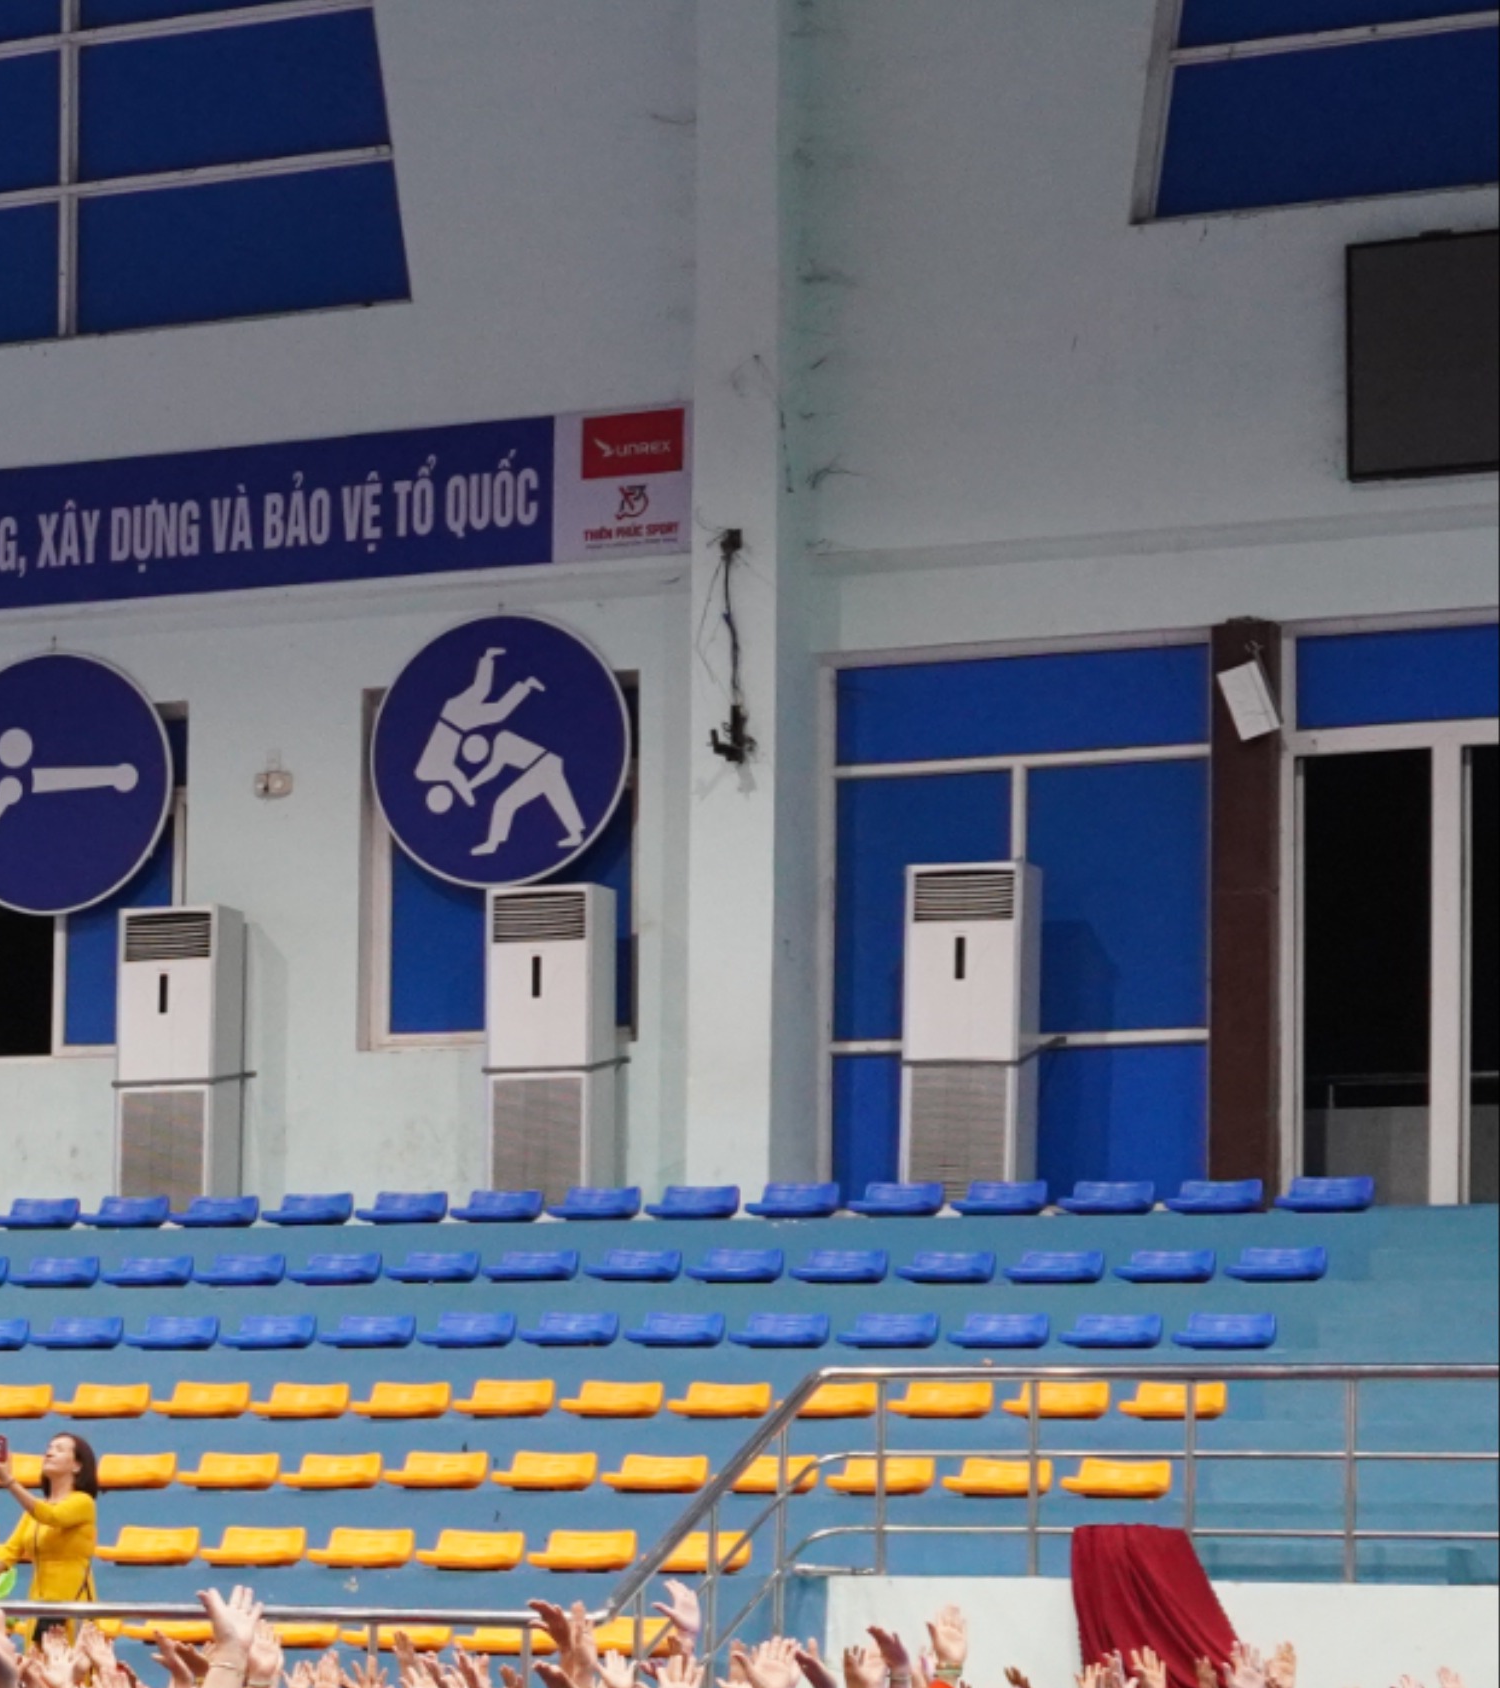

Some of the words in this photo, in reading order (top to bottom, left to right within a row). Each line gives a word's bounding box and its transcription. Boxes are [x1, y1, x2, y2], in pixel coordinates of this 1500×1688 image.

[37, 499, 100, 568] XÂY
[110, 497, 199, 573] DỰNG
[211, 484, 253, 553] VÀ
[263, 470, 330, 550] BẢO
[342, 471, 382, 552] VỆ
[393, 454, 437, 537] TỔ
[446, 448, 538, 538] QUỐC
